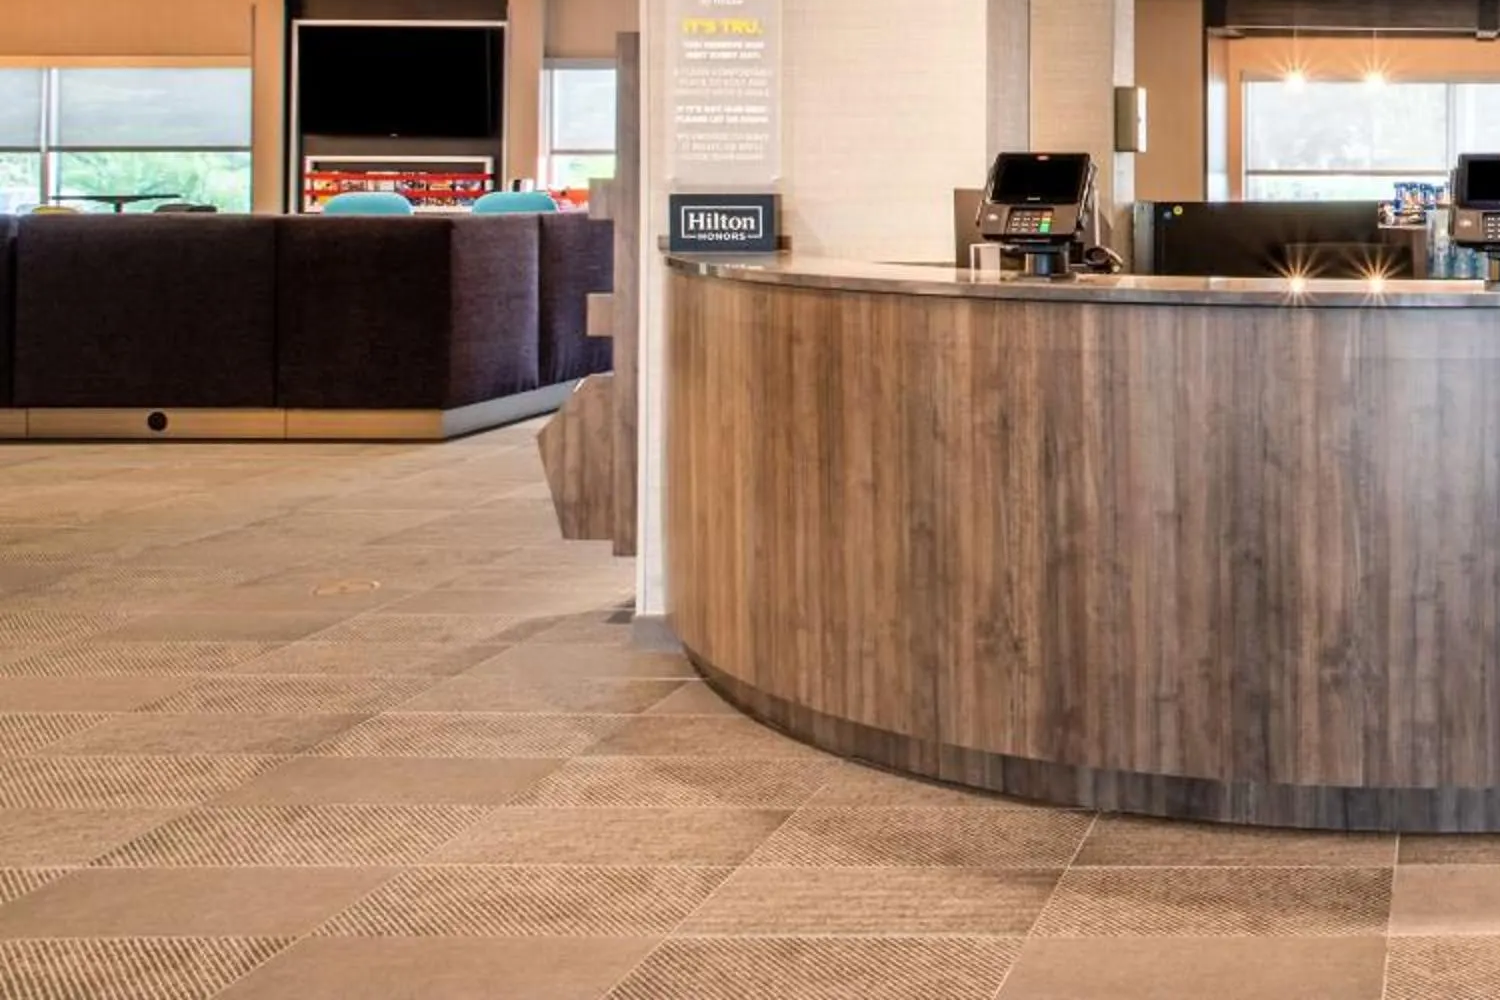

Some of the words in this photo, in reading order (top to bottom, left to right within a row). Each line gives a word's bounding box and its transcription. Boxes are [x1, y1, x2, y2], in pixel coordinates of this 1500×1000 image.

[683, 17, 717, 34] IT'S
[688, 212, 756, 231] Hilton
[697, 232, 747, 241] HONORS
